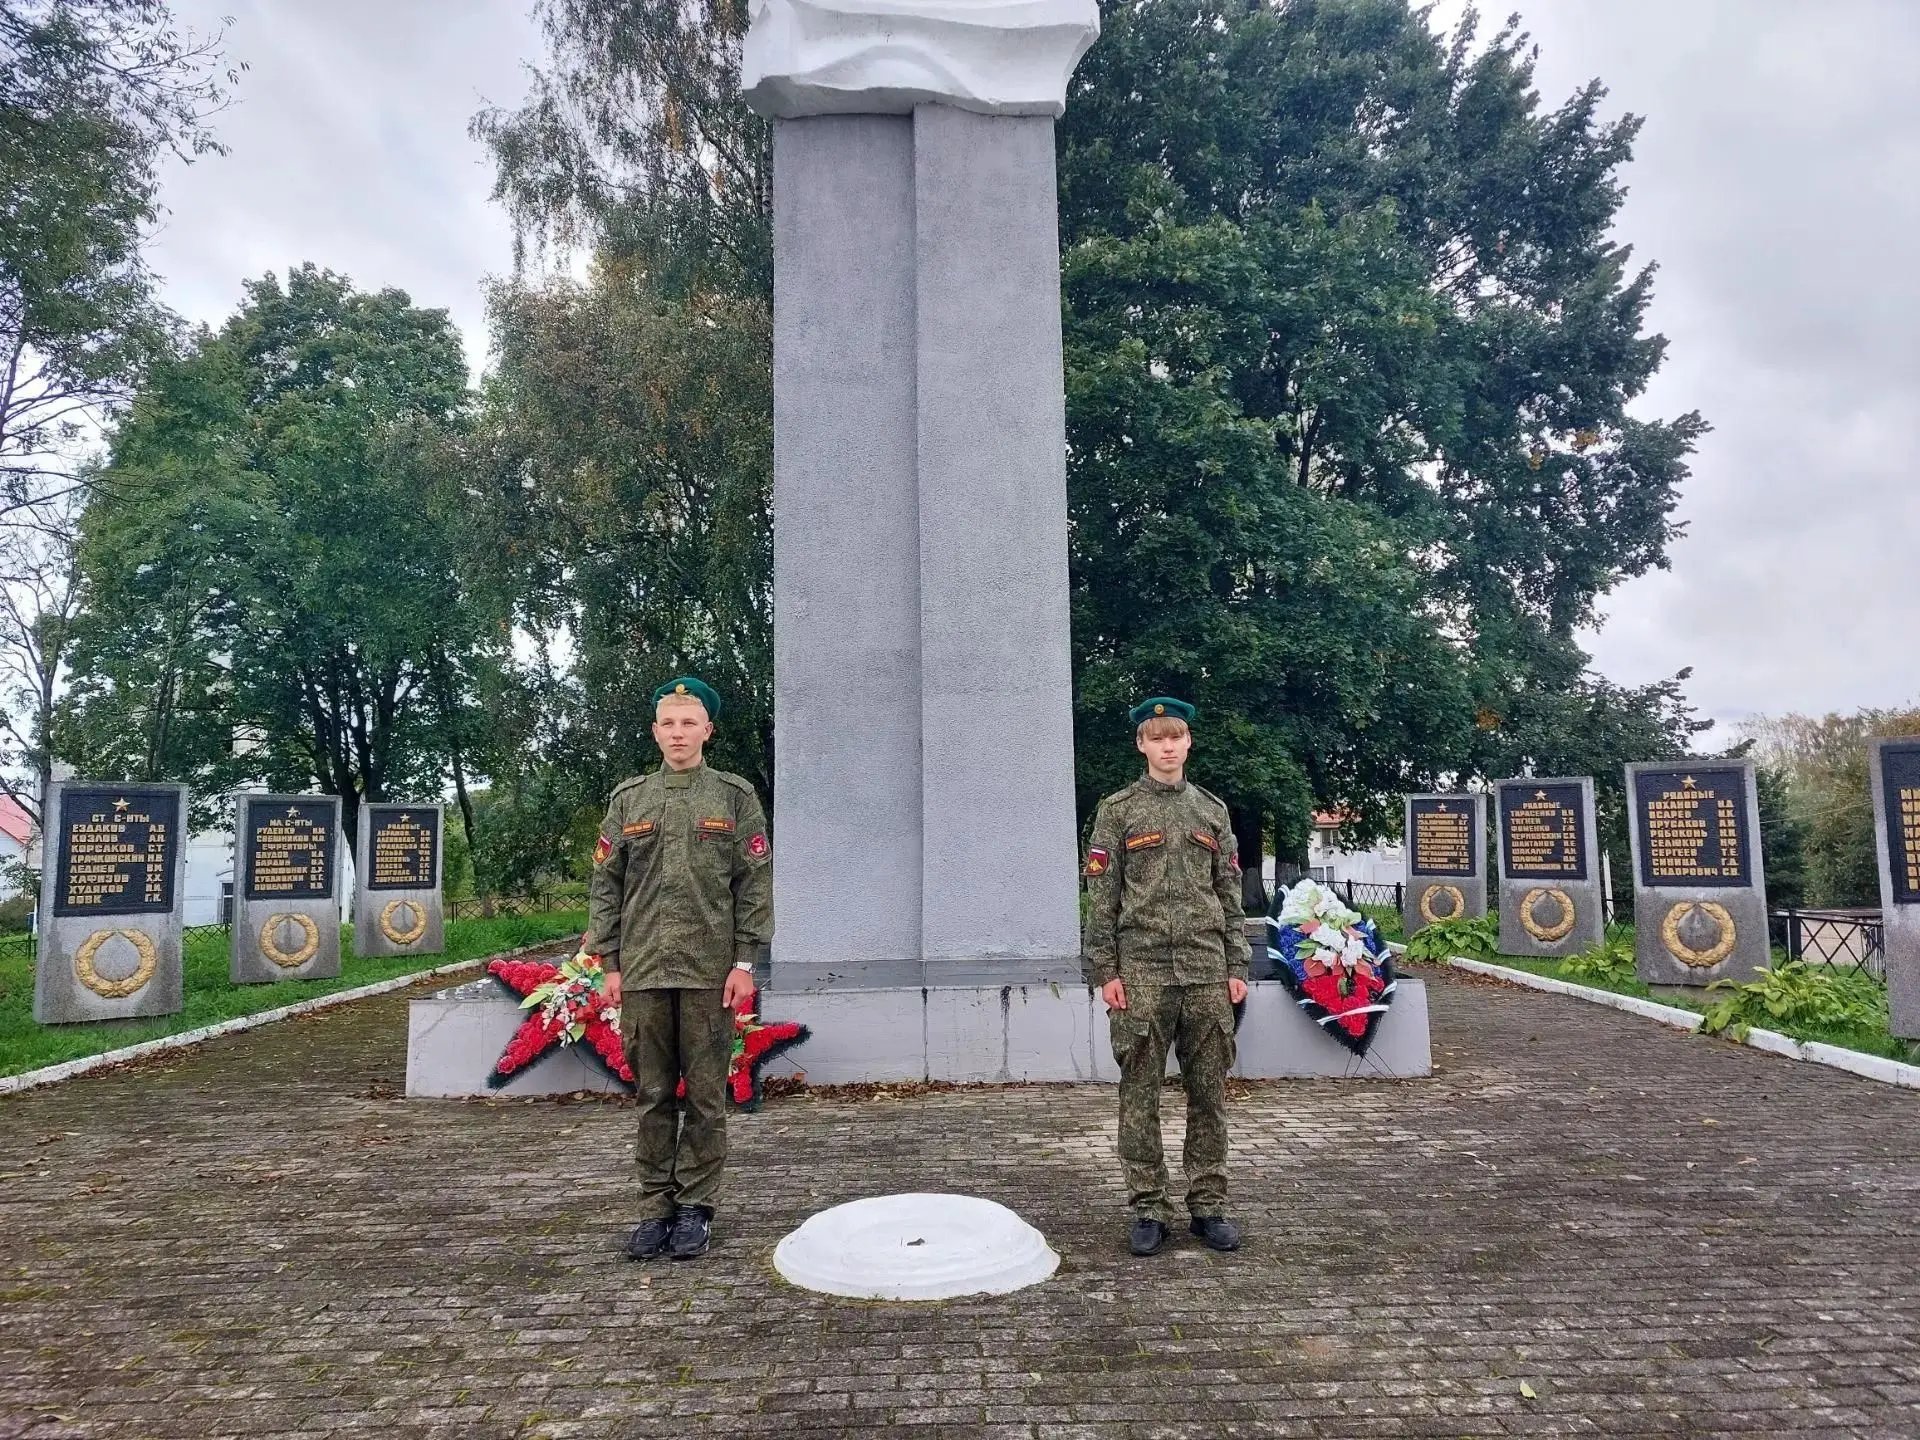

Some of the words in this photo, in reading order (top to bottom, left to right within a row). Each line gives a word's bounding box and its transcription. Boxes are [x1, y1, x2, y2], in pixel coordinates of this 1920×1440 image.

[1663, 791, 1714, 799] РЯДОВЫЕ
[72, 824, 125, 832] ЕЗДАКОВ
[1650, 820, 1706, 828] ПРУСАКОВ
[1650, 829, 1708, 837] РЯБОКОНЬ
[1651, 839, 1703, 847] СЕЛЮКОВ
[1653, 858, 1697, 866] СИНИЦА
[70, 865, 115, 873] ЛЕДНЕВ
[1654, 867, 1718, 876] СИДОРОВИЧ
[70, 874, 129, 883] ХАФИЗОВ
[69, 885, 123, 894] ХУДЯКОВ
[68, 895, 102, 904] ВОВК
